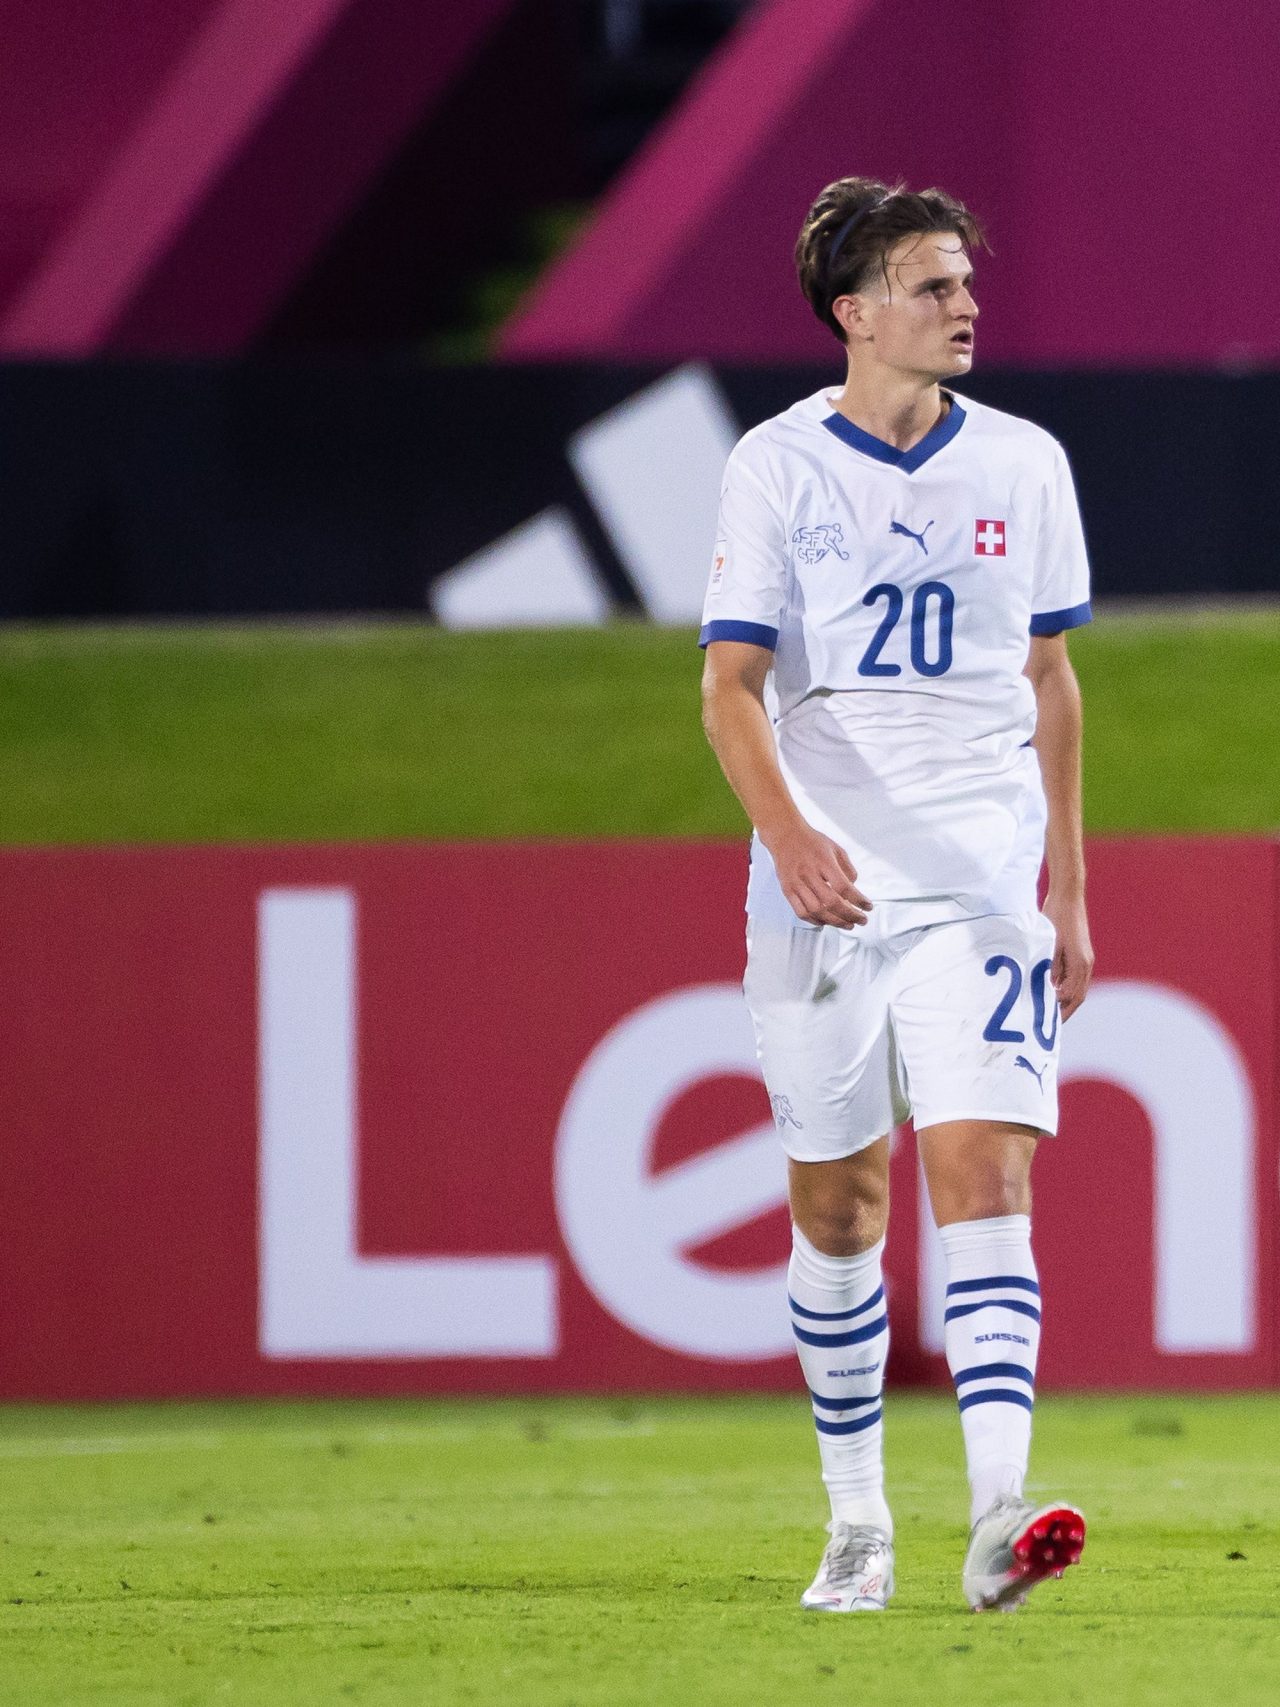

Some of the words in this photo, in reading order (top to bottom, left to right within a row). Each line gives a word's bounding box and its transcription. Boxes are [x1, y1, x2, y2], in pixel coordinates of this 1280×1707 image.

[857, 581, 955, 677] 20
[982, 955, 1057, 1051] 20
[974, 1332, 1030, 1346] SUISSE
